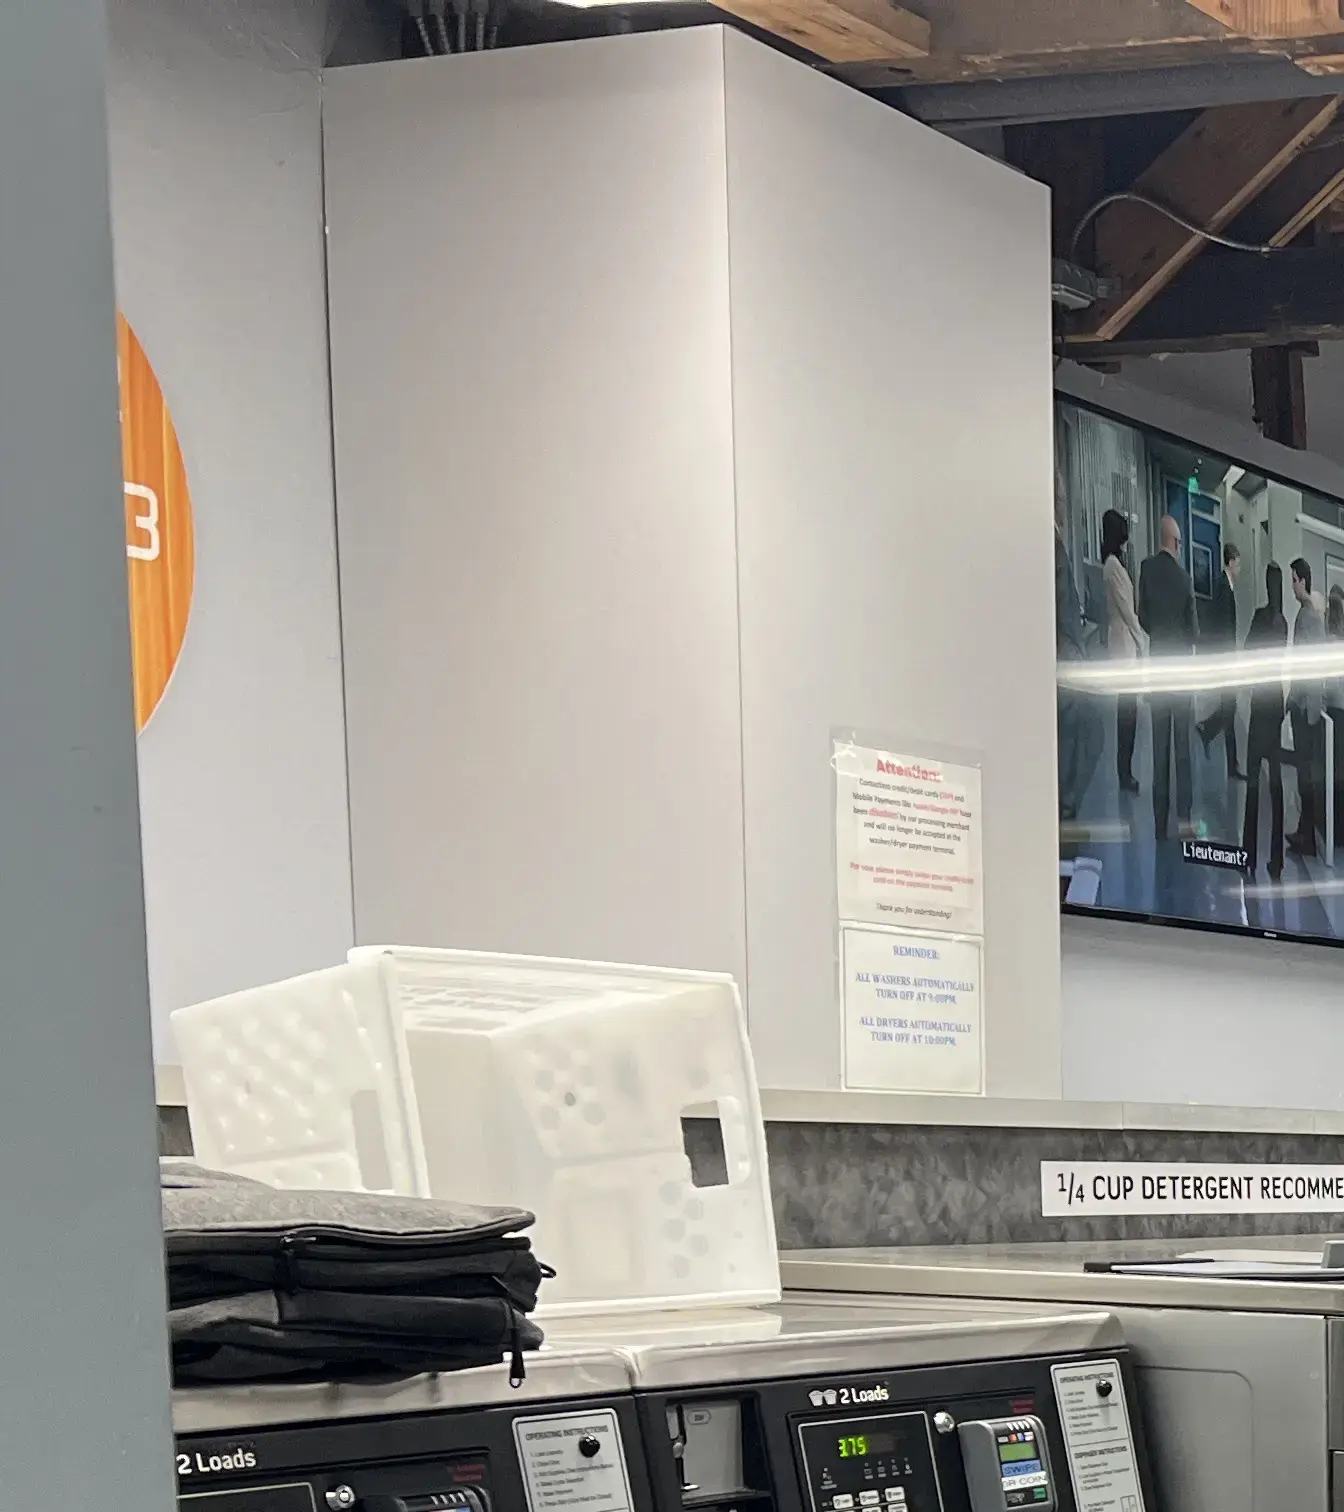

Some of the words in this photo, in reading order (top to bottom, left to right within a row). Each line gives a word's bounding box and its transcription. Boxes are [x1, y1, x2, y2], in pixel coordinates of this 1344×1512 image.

[1183, 841, 1248, 866] Lieutenant?
[893, 945, 940, 960] REMINDER:
[856, 972, 871, 983] ALL
[872, 973, 911, 986] WASHERS
[912, 977, 974, 992] AUTOMATICALLY
[876, 988, 898, 1000] TURN
[900, 990, 915, 1001] OFF
[916, 992, 927, 1002] AT
[860, 1016, 874, 1027] ALL
[876, 1017, 909, 1029] DRYERS
[909, 1020, 972, 1034] AUTOMATICALLY
[871, 1031, 893, 1042] TURN
[895, 1033, 910, 1044] OFF
[911, 1034, 922, 1044] AT
[1092, 1175, 1134, 1201] CUP
[1141, 1175, 1253, 1201] DETERGENT
[839, 1388, 850, 1404] 2
[851, 1385, 889, 1403] Loads
[838, 1436, 867, 1458] 375
[176, 1454, 193, 1475] 2
[196, 1448, 257, 1472] Loads
[1004, 1463, 1039, 1475] SWIPE
